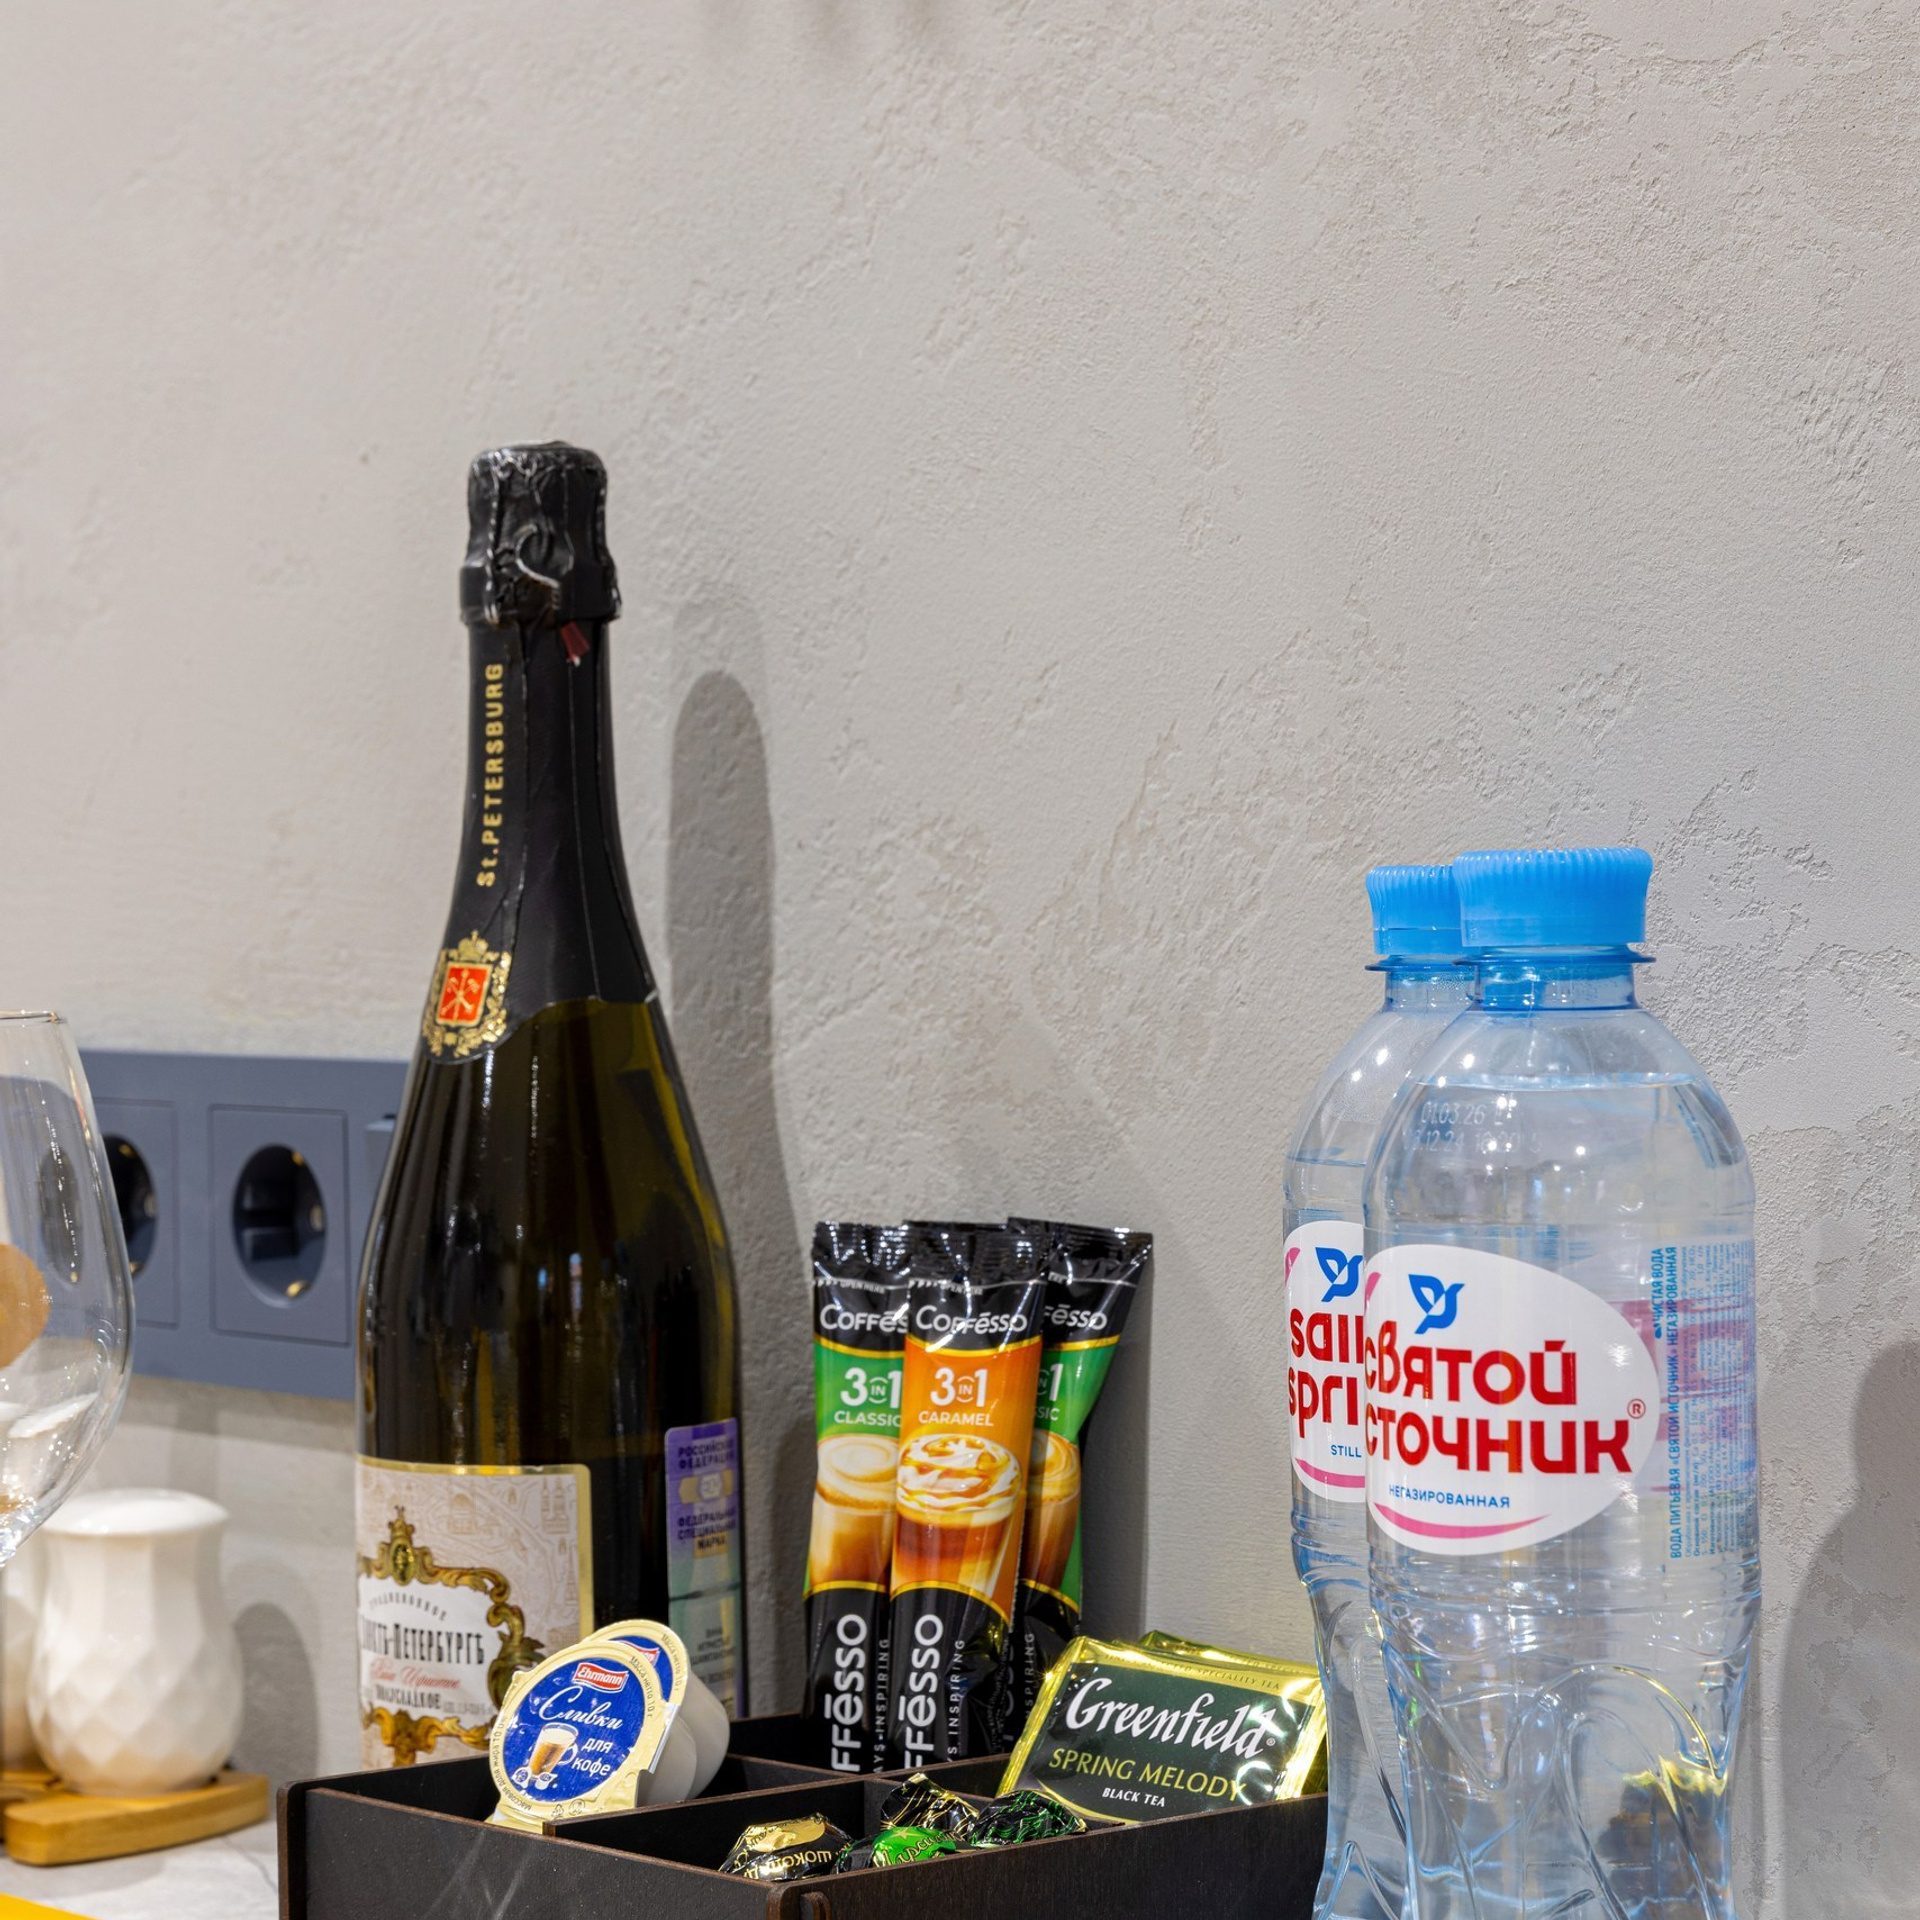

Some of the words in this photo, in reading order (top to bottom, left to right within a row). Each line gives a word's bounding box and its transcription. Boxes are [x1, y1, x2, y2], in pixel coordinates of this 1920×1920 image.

[477, 663, 504, 887] St.PETERSBURG
[1651, 1248, 1663, 1278] ВОДА
[1652, 1281, 1664, 1322] ЧИСТАЯ
[1665, 1246, 1679, 1346] НЕГАЗИРОВАННАЯ
[918, 1410, 994, 1427] CARAMEL
[1035, 1406, 1060, 1421] SIC
[1331, 1444, 1362, 1459] STILL
[1389, 1485, 1510, 1509] НЕГАЗИРОВАННАЯ
[1668, 1469, 1681, 1526] ПИТЬЕВАЯ
[1669, 1528, 1682, 1558] ВОДА
[577, 1665, 623, 1686] Ehrmann
[875, 1638, 889, 1734] INSPIRING
[948, 1639, 965, 1735] INSPIRING
[1197, 1668, 1257, 1686] SPECIALITY
[1261, 1680, 1280, 1691] TEA
[539, 1685, 623, 1730] Сливки
[1065, 1677, 1276, 1758] Greenfield
[581, 1737, 613, 1754] для
[571, 1757, 611, 1777] кофе
[1049, 1747, 1148, 1779] SPRING
[1151, 1762, 1246, 1803] MELODY
[1101, 1786, 1141, 1806] BLACK
[1143, 1792, 1166, 1808] TEA
